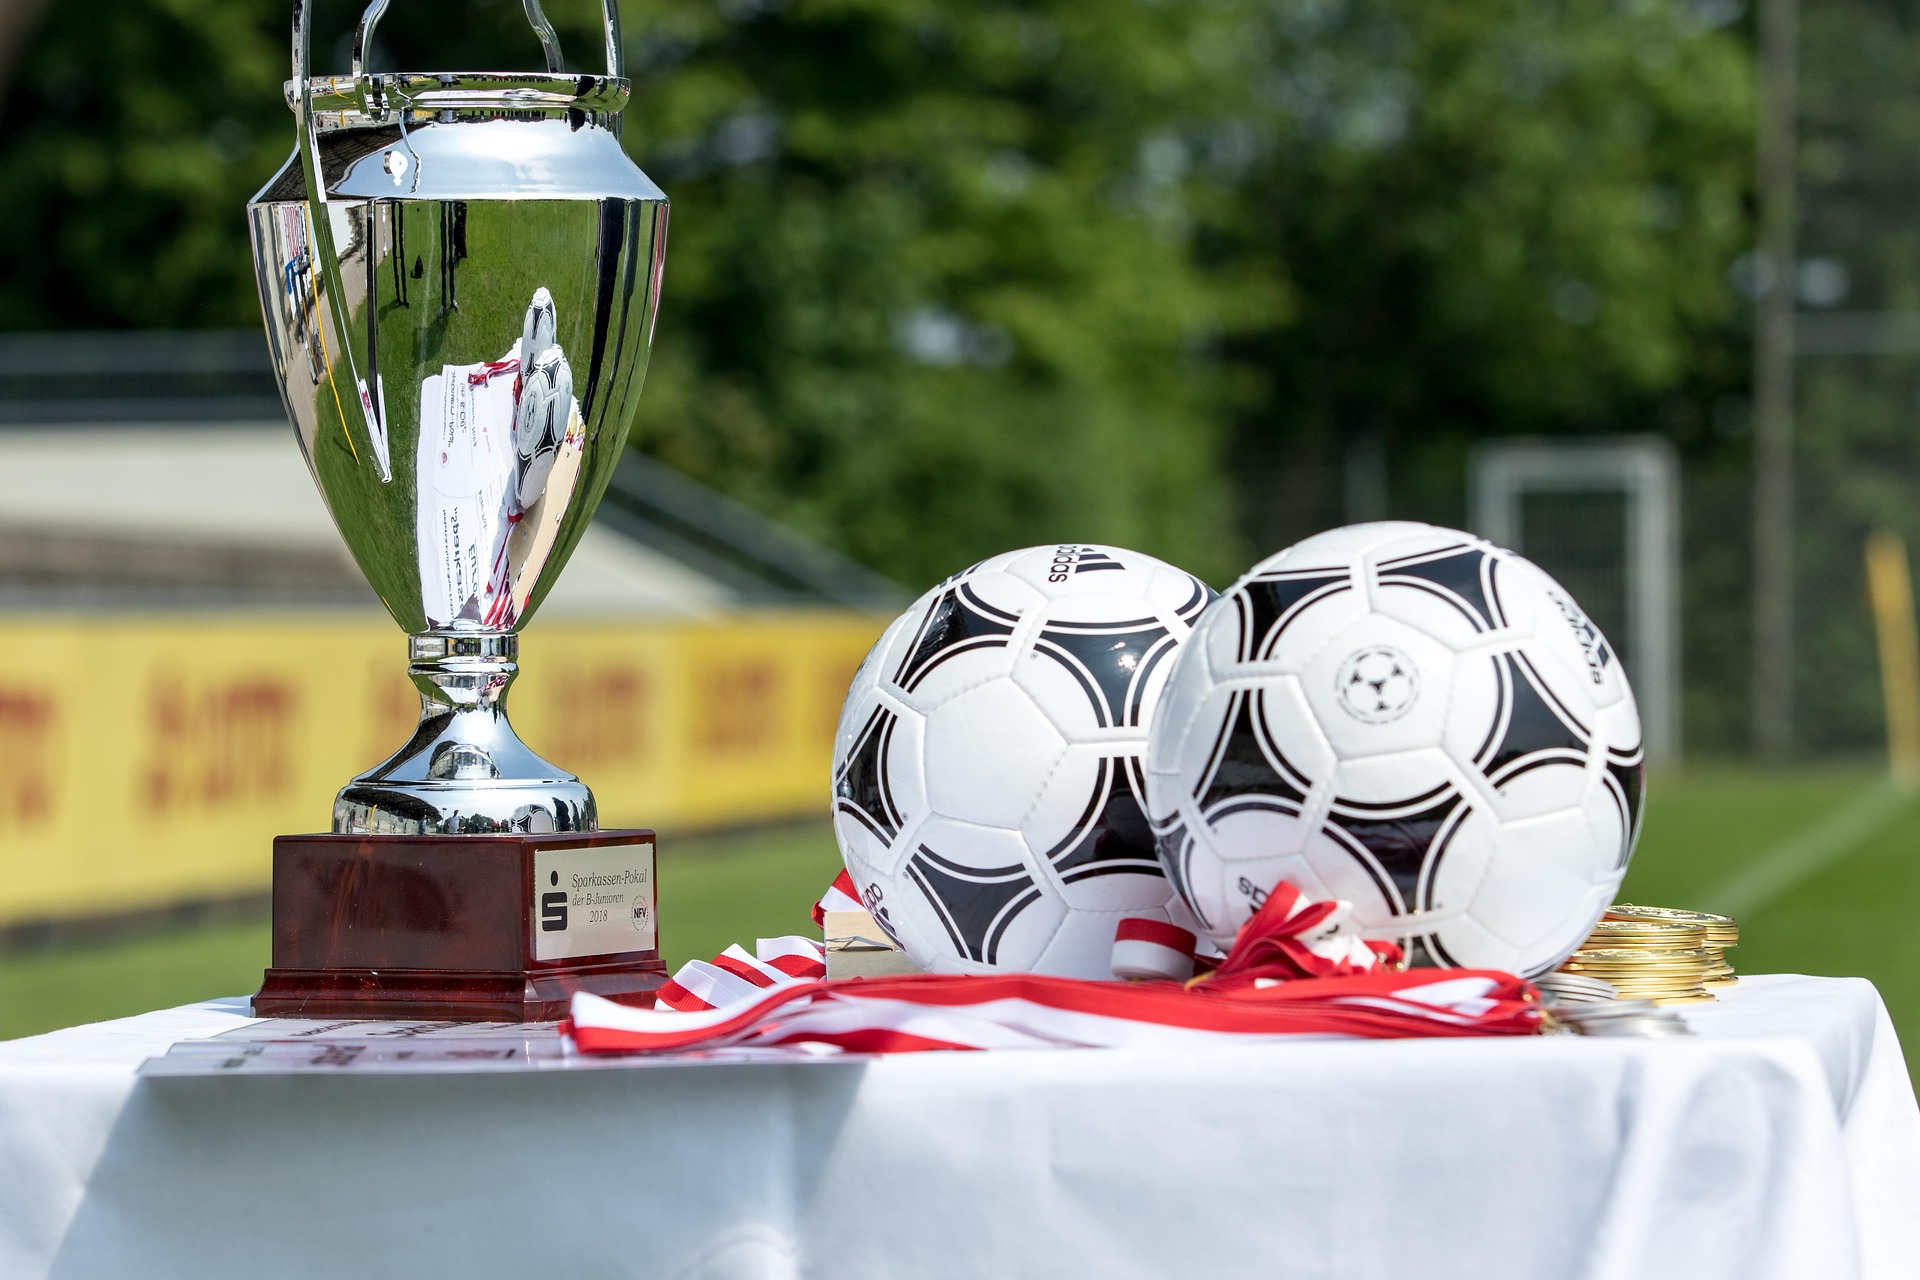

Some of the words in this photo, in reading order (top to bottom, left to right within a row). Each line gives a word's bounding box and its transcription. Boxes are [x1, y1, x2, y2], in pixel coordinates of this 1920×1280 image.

[571, 868, 648, 892] Sparkassen-Pokal
[571, 894, 585, 907] der
[586, 892, 625, 906] B-Junioren
[589, 909, 608, 923] 2018
[633, 907, 647, 919] NFV
